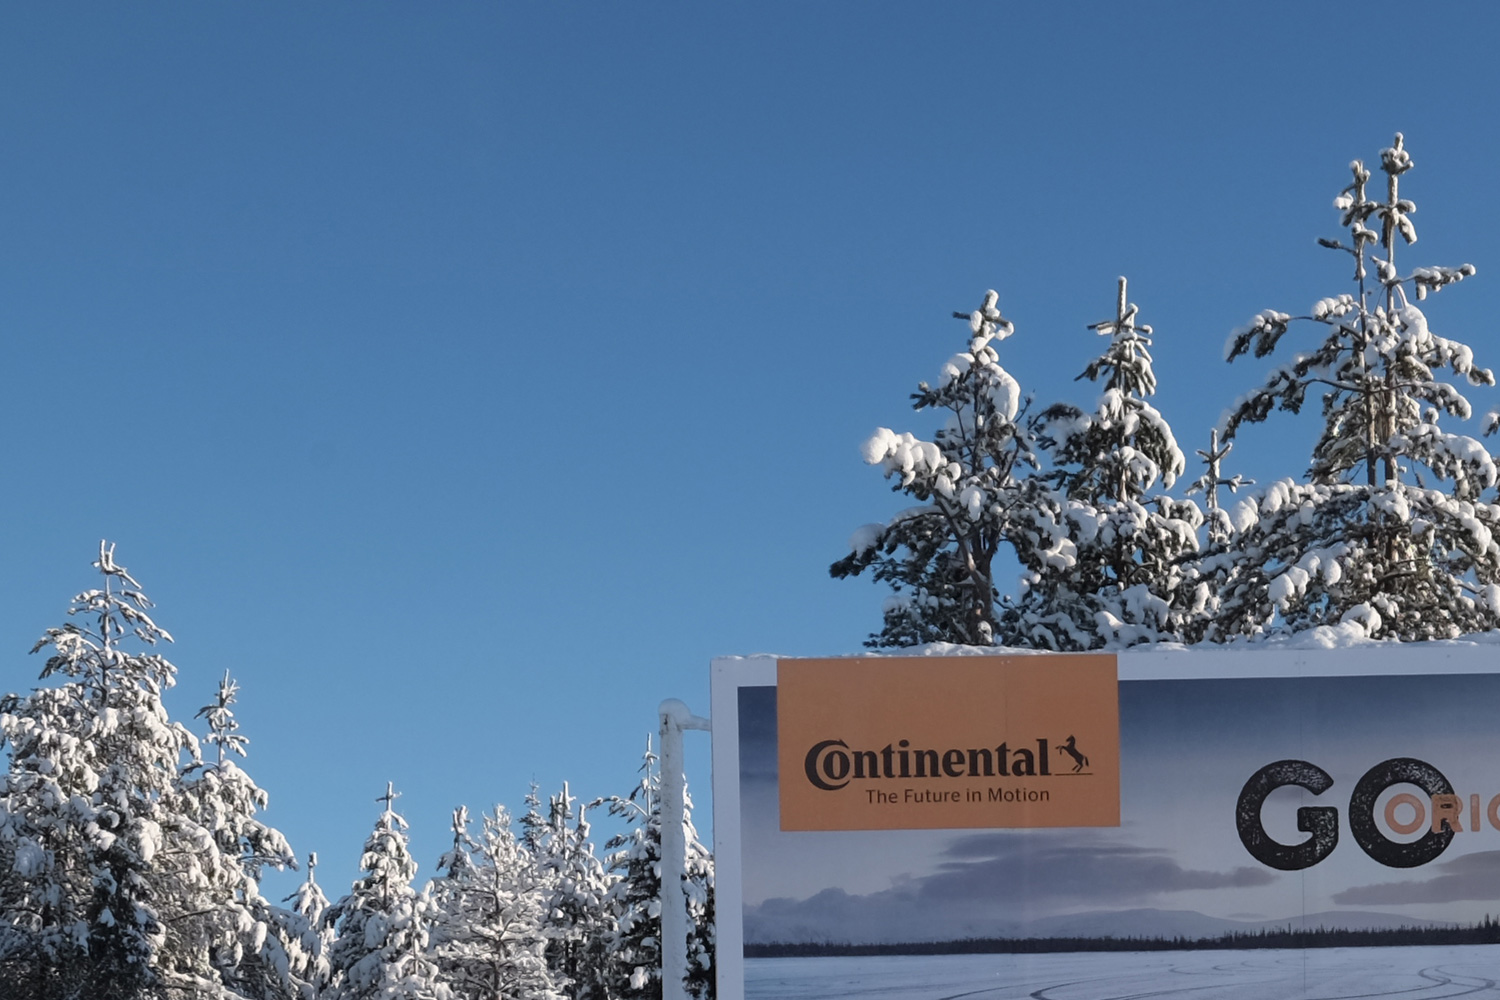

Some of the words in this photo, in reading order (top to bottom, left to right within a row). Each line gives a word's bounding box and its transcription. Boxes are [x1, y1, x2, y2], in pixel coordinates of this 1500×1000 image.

[804, 738, 1052, 791] Continental
[866, 789, 898, 804] The
[904, 788, 960, 803] Future
[966, 788, 982, 802] in
[988, 787, 1050, 802] Motion
[1235, 757, 1458, 870] GO
